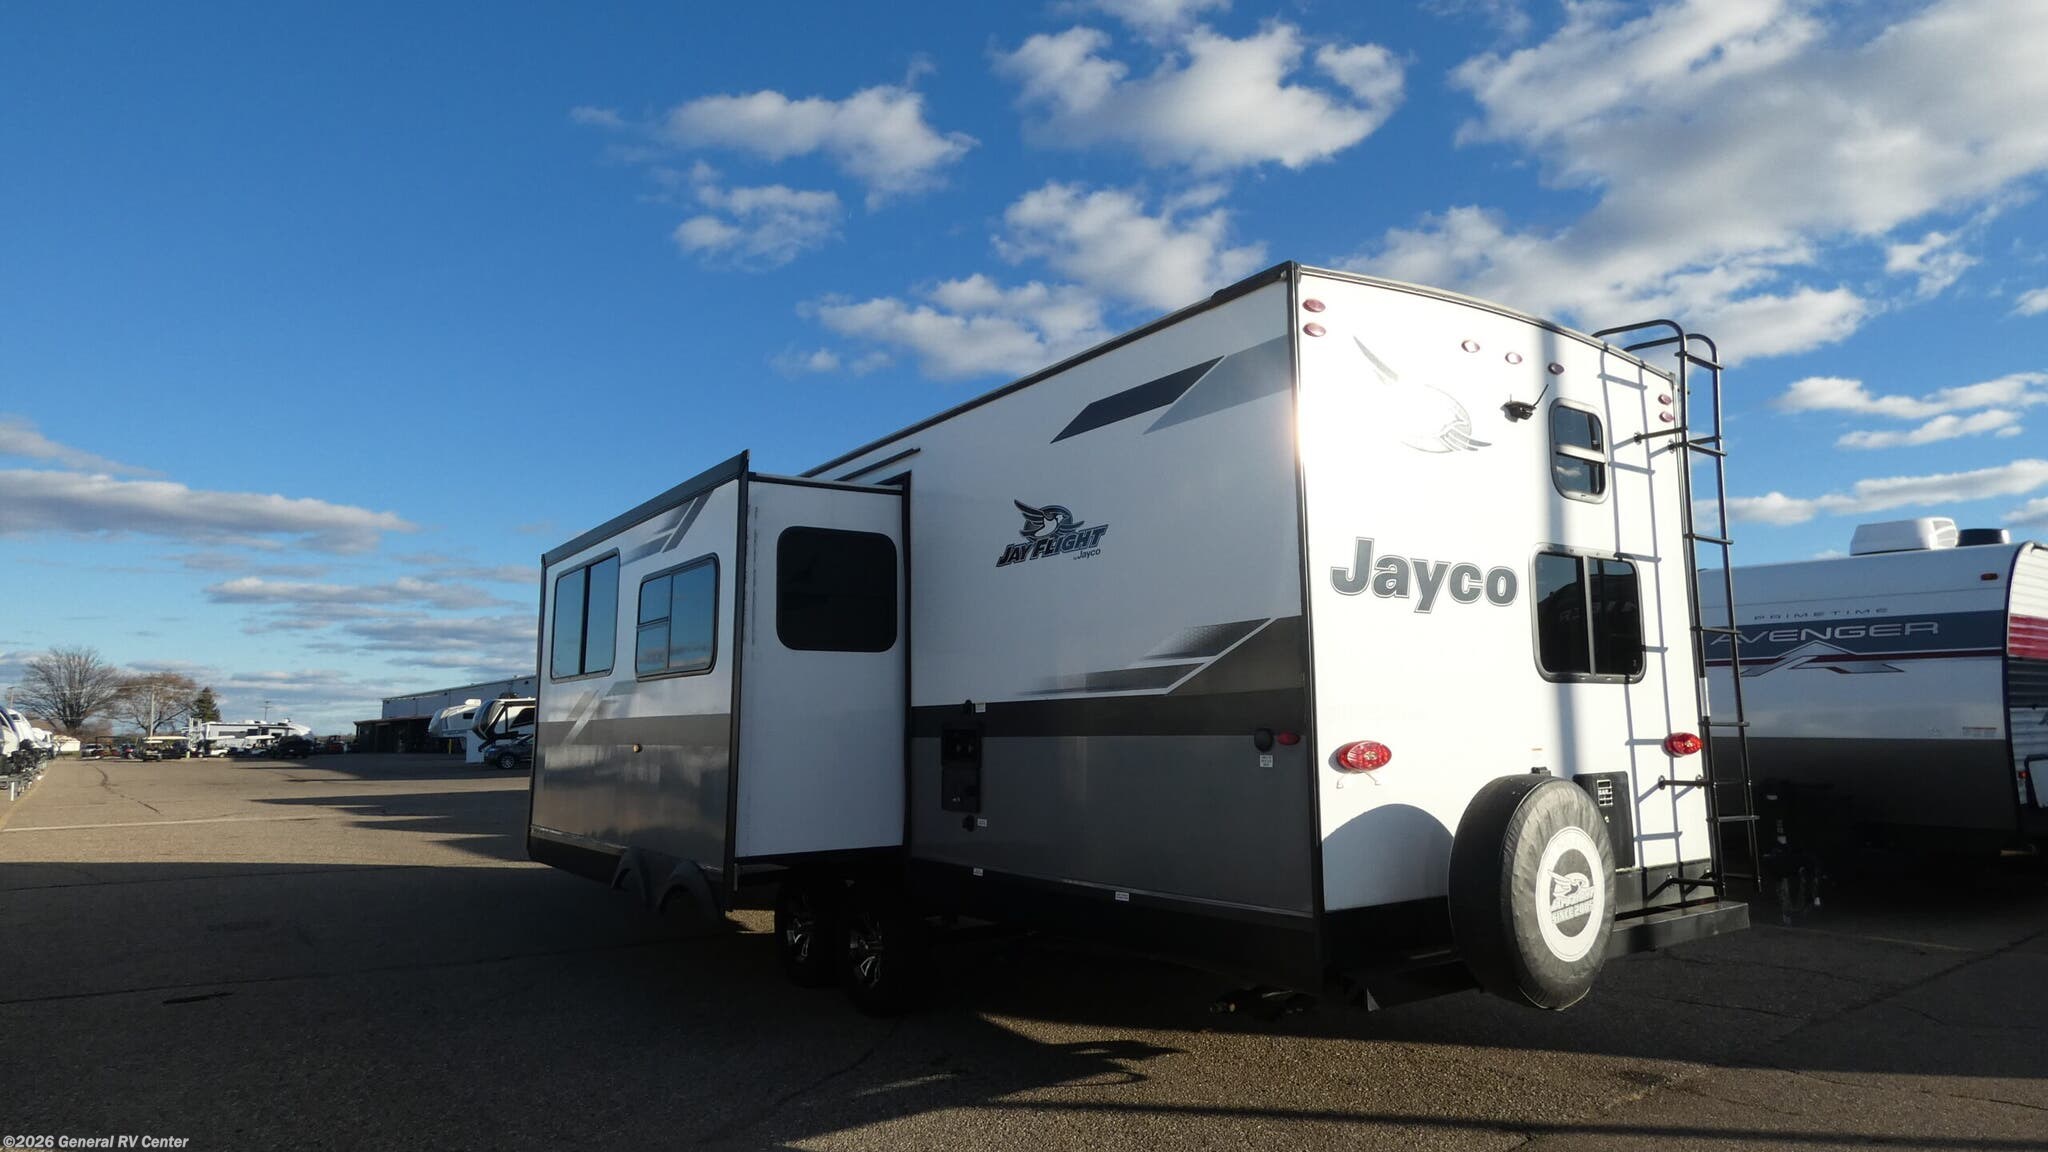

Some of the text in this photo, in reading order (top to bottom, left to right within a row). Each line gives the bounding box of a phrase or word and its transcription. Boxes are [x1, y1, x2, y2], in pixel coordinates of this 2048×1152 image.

[996, 524, 1109, 568] JAY FLIGHT
[1077, 548, 1101, 560] Jayco
[1330, 536, 1519, 614] Jayco
[1710, 621, 1939, 646] AVENGER
